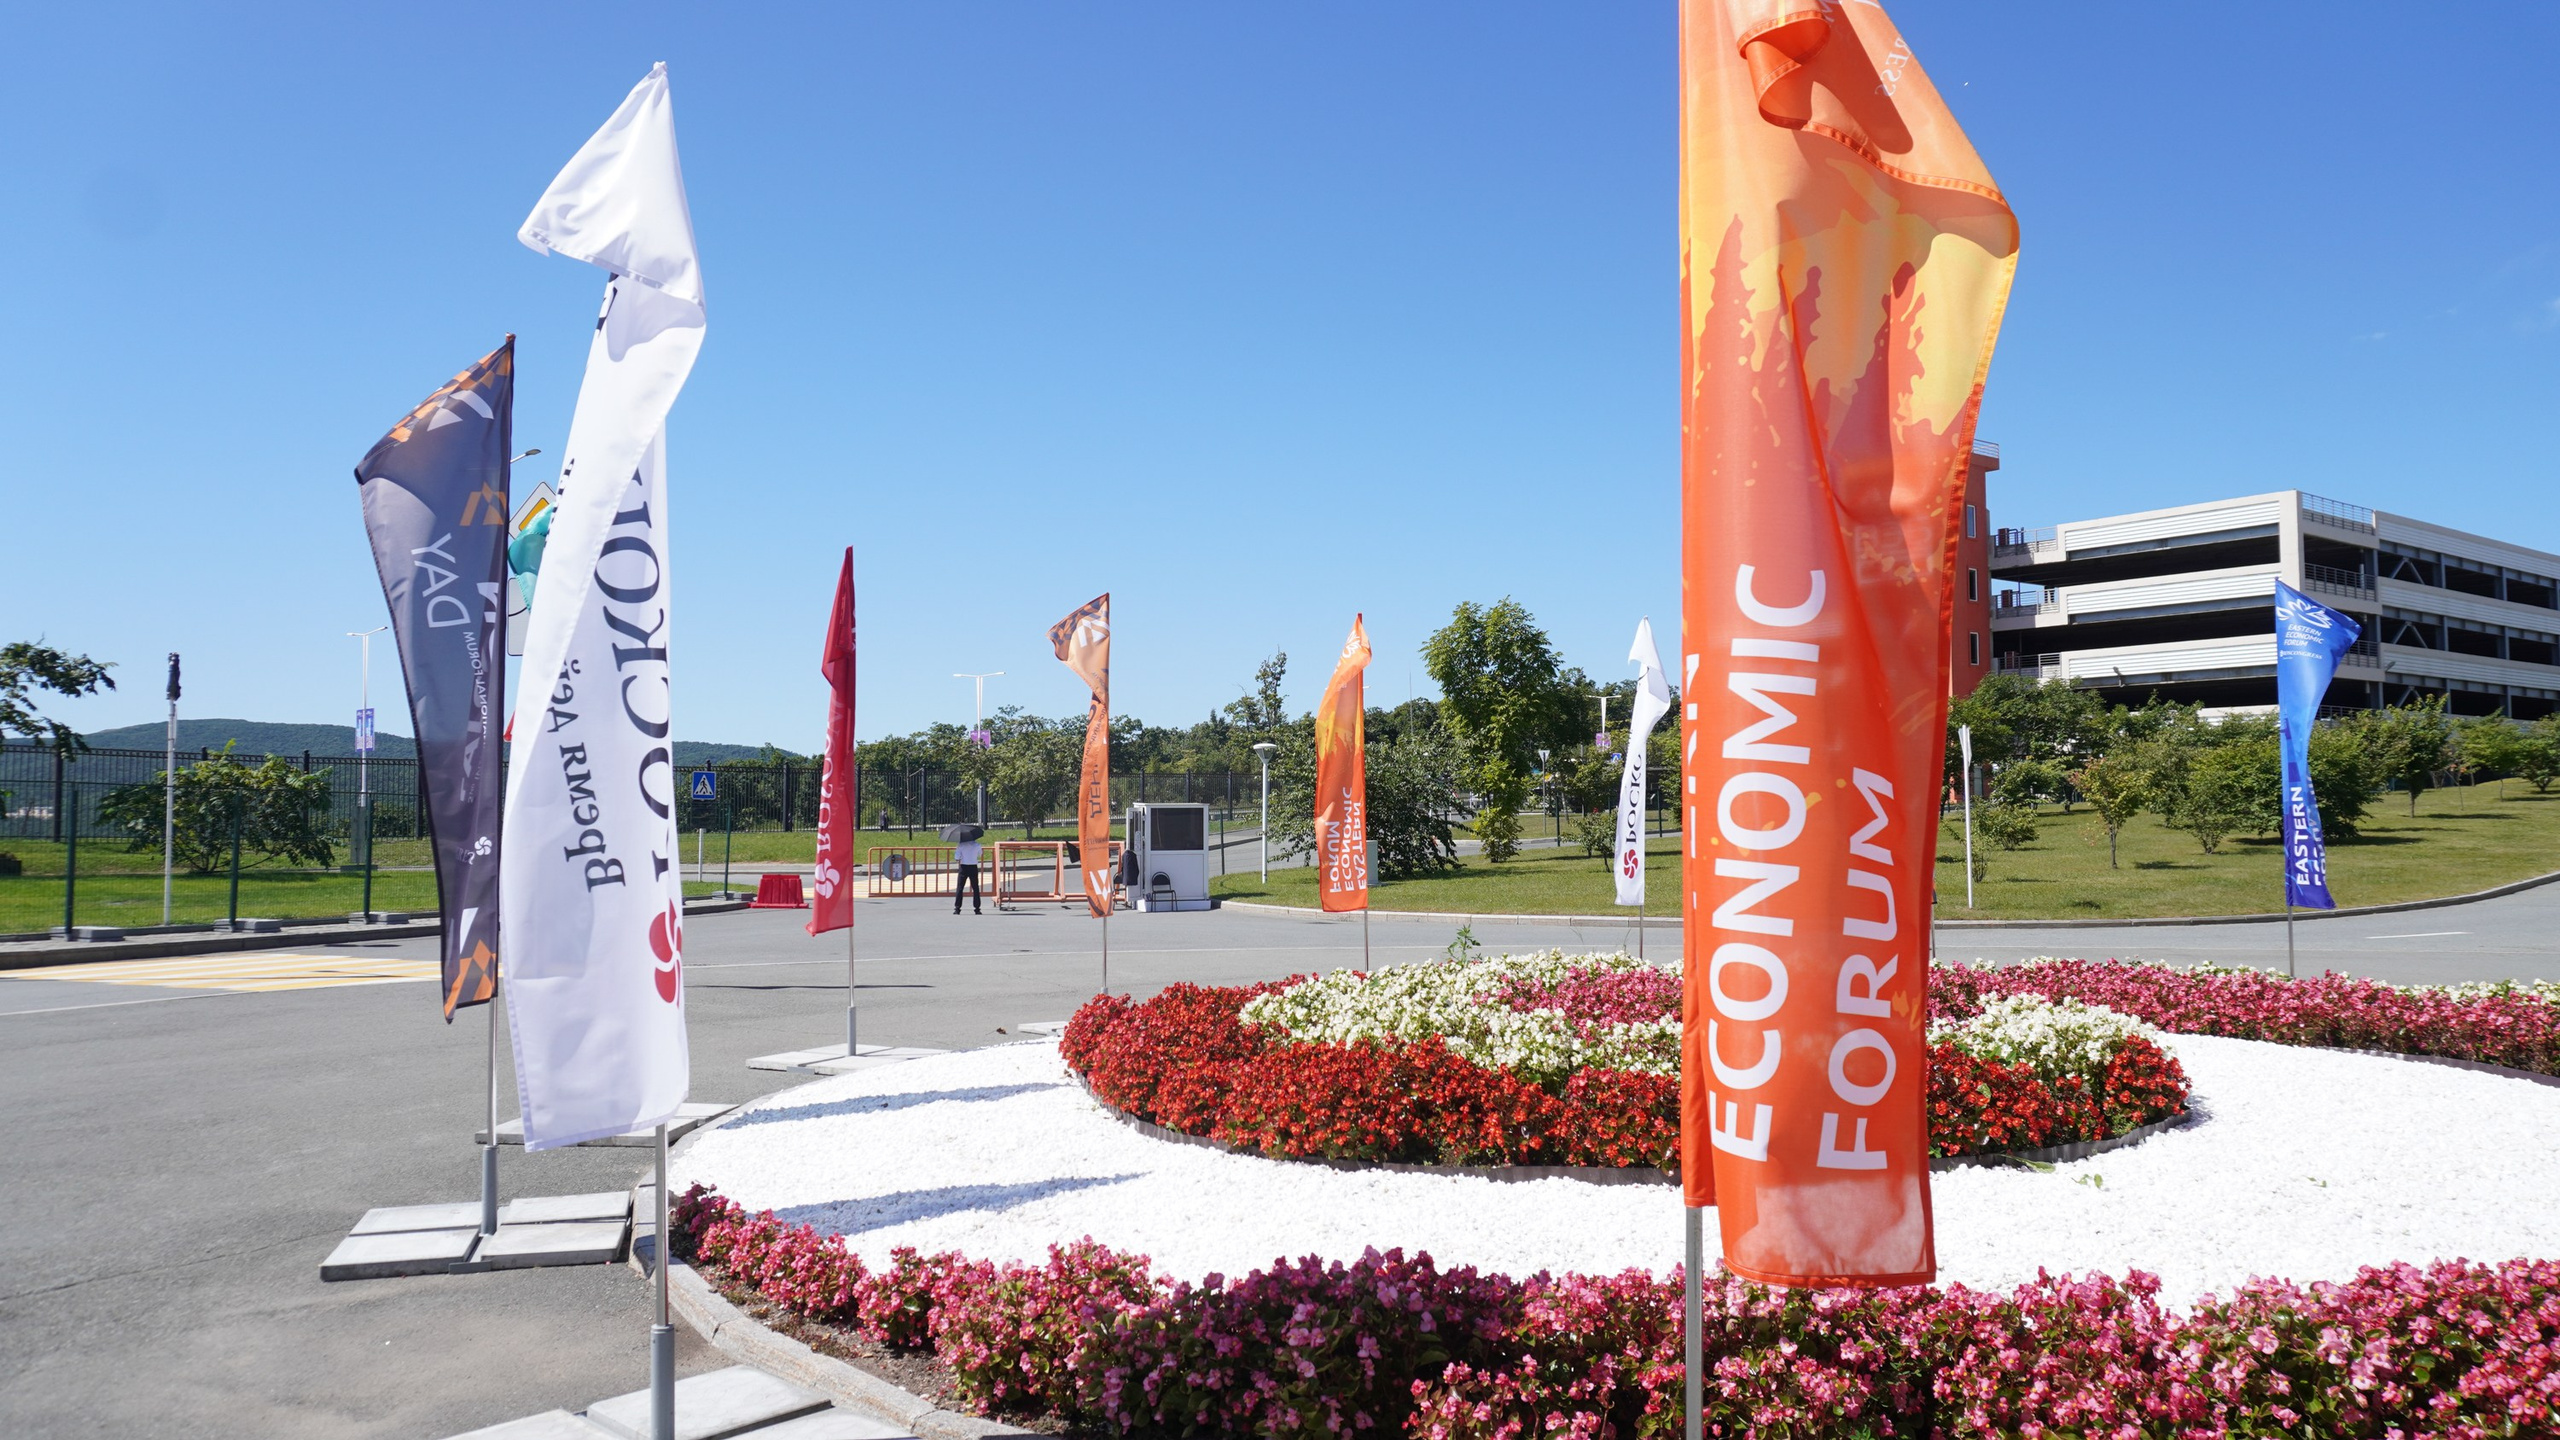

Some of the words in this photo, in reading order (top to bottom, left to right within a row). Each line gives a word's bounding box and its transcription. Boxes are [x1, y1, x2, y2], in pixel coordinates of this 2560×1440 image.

[2283, 638, 2309, 647] FORUM
[2285, 631, 2325, 645] ECONOMIC
[2287, 623, 2322, 637] EASTERN
[1708, 564, 1826, 1162] ECONOMIC
[2290, 786, 2311, 886] EASTERN
[1816, 766, 1898, 1170] FORUM
